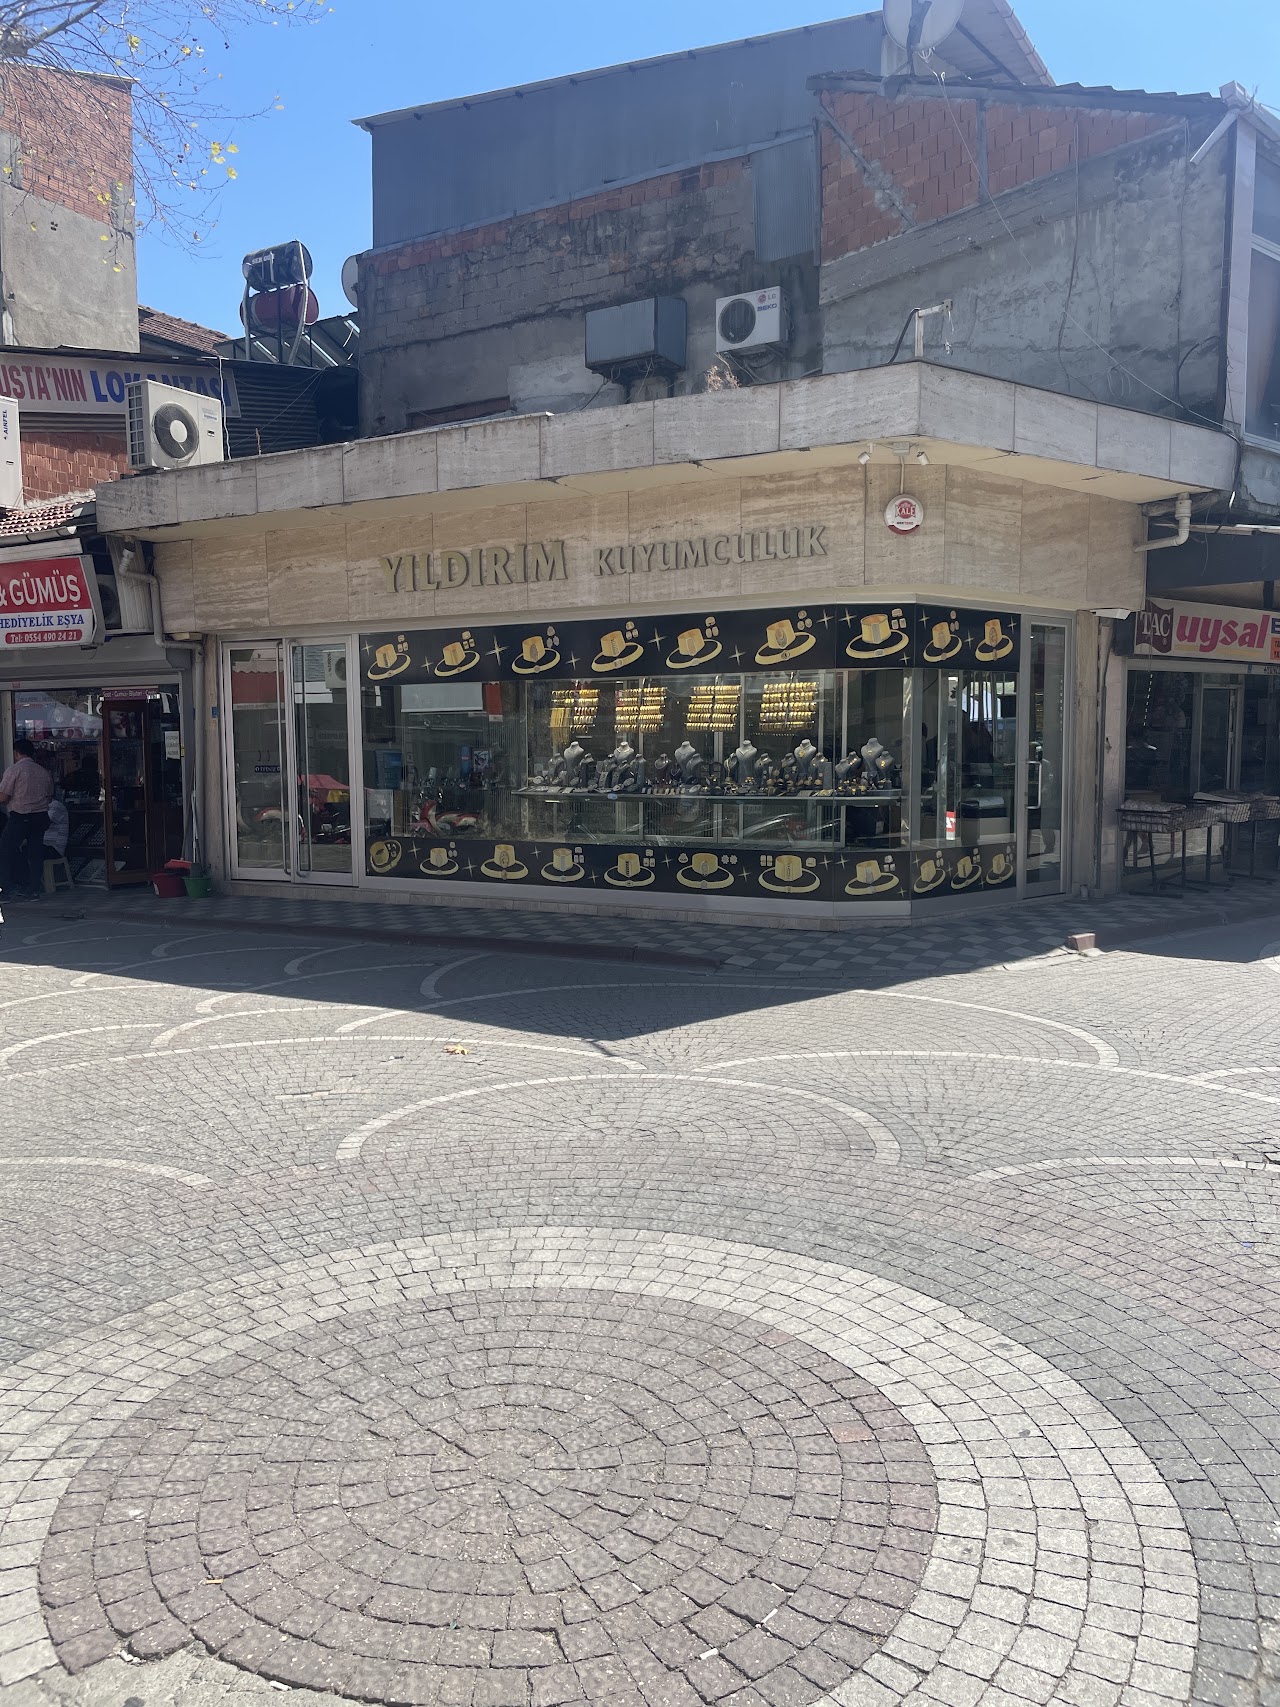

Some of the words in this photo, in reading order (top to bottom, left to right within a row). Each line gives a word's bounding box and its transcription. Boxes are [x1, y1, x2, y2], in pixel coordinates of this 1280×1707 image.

[379, 540, 568, 593] YILDIRIM
[594, 526, 827, 576] KUYUMCULUK
[9, 569, 81, 608] GÜMÜŞ
[0, 613, 54, 629] HEDİYELİK
[57, 614, 84, 628] EŞYA
[11, 634, 22, 643] Tel:
[24, 632, 41, 642] 0554
[43, 632, 56, 642] 490
[58, 631, 67, 640] 24
[68, 631, 77, 640] 21
[1176, 614, 1270, 653] uysal
